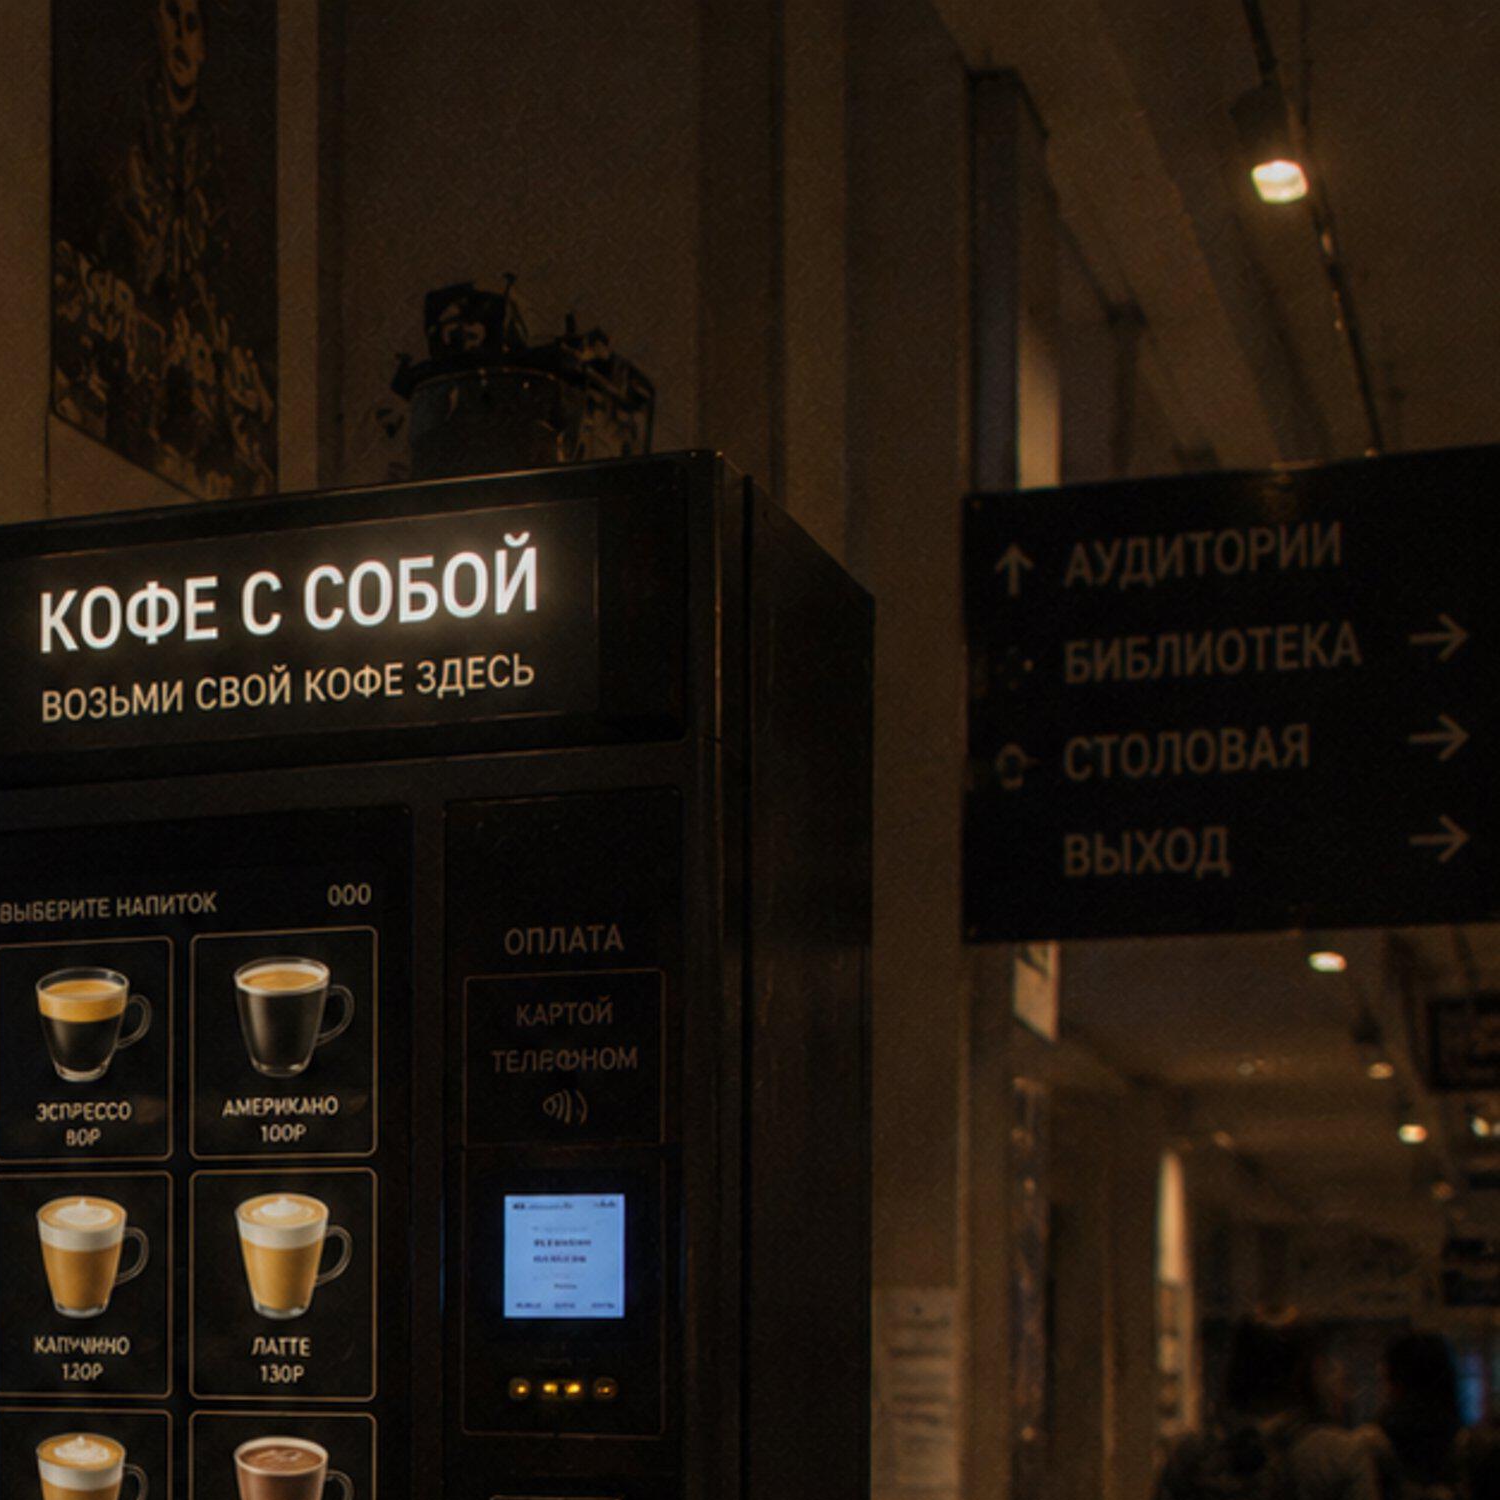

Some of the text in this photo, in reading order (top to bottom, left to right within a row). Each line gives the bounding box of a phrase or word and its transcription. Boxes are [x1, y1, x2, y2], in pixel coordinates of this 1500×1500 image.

[1062, 520, 1344, 590] АУДИТОРИИ
[39, 531, 538, 654] КОФЕ С СОБОЙ
[1062, 618, 1364, 686] БИБЛИОТЕКА
[41, 652, 536, 724] ВОЗЬМИ СВОЙ КОФЕ ЗДЕСЬ
[1062, 722, 1312, 783] СТОЛОВАЯ
[1062, 825, 1233, 879] ВЫХОД
[116, 888, 220, 918] НАПИТОК
[503, 923, 626, 956] ОПЛАТА
[515, 994, 614, 1028] КАРТОЙ
[35, 1101, 133, 1123] ЭСПРЕССО
[222, 1095, 340, 1118] АМЕРИКАНО
[250, 1335, 312, 1358] ЛАТТЕ
